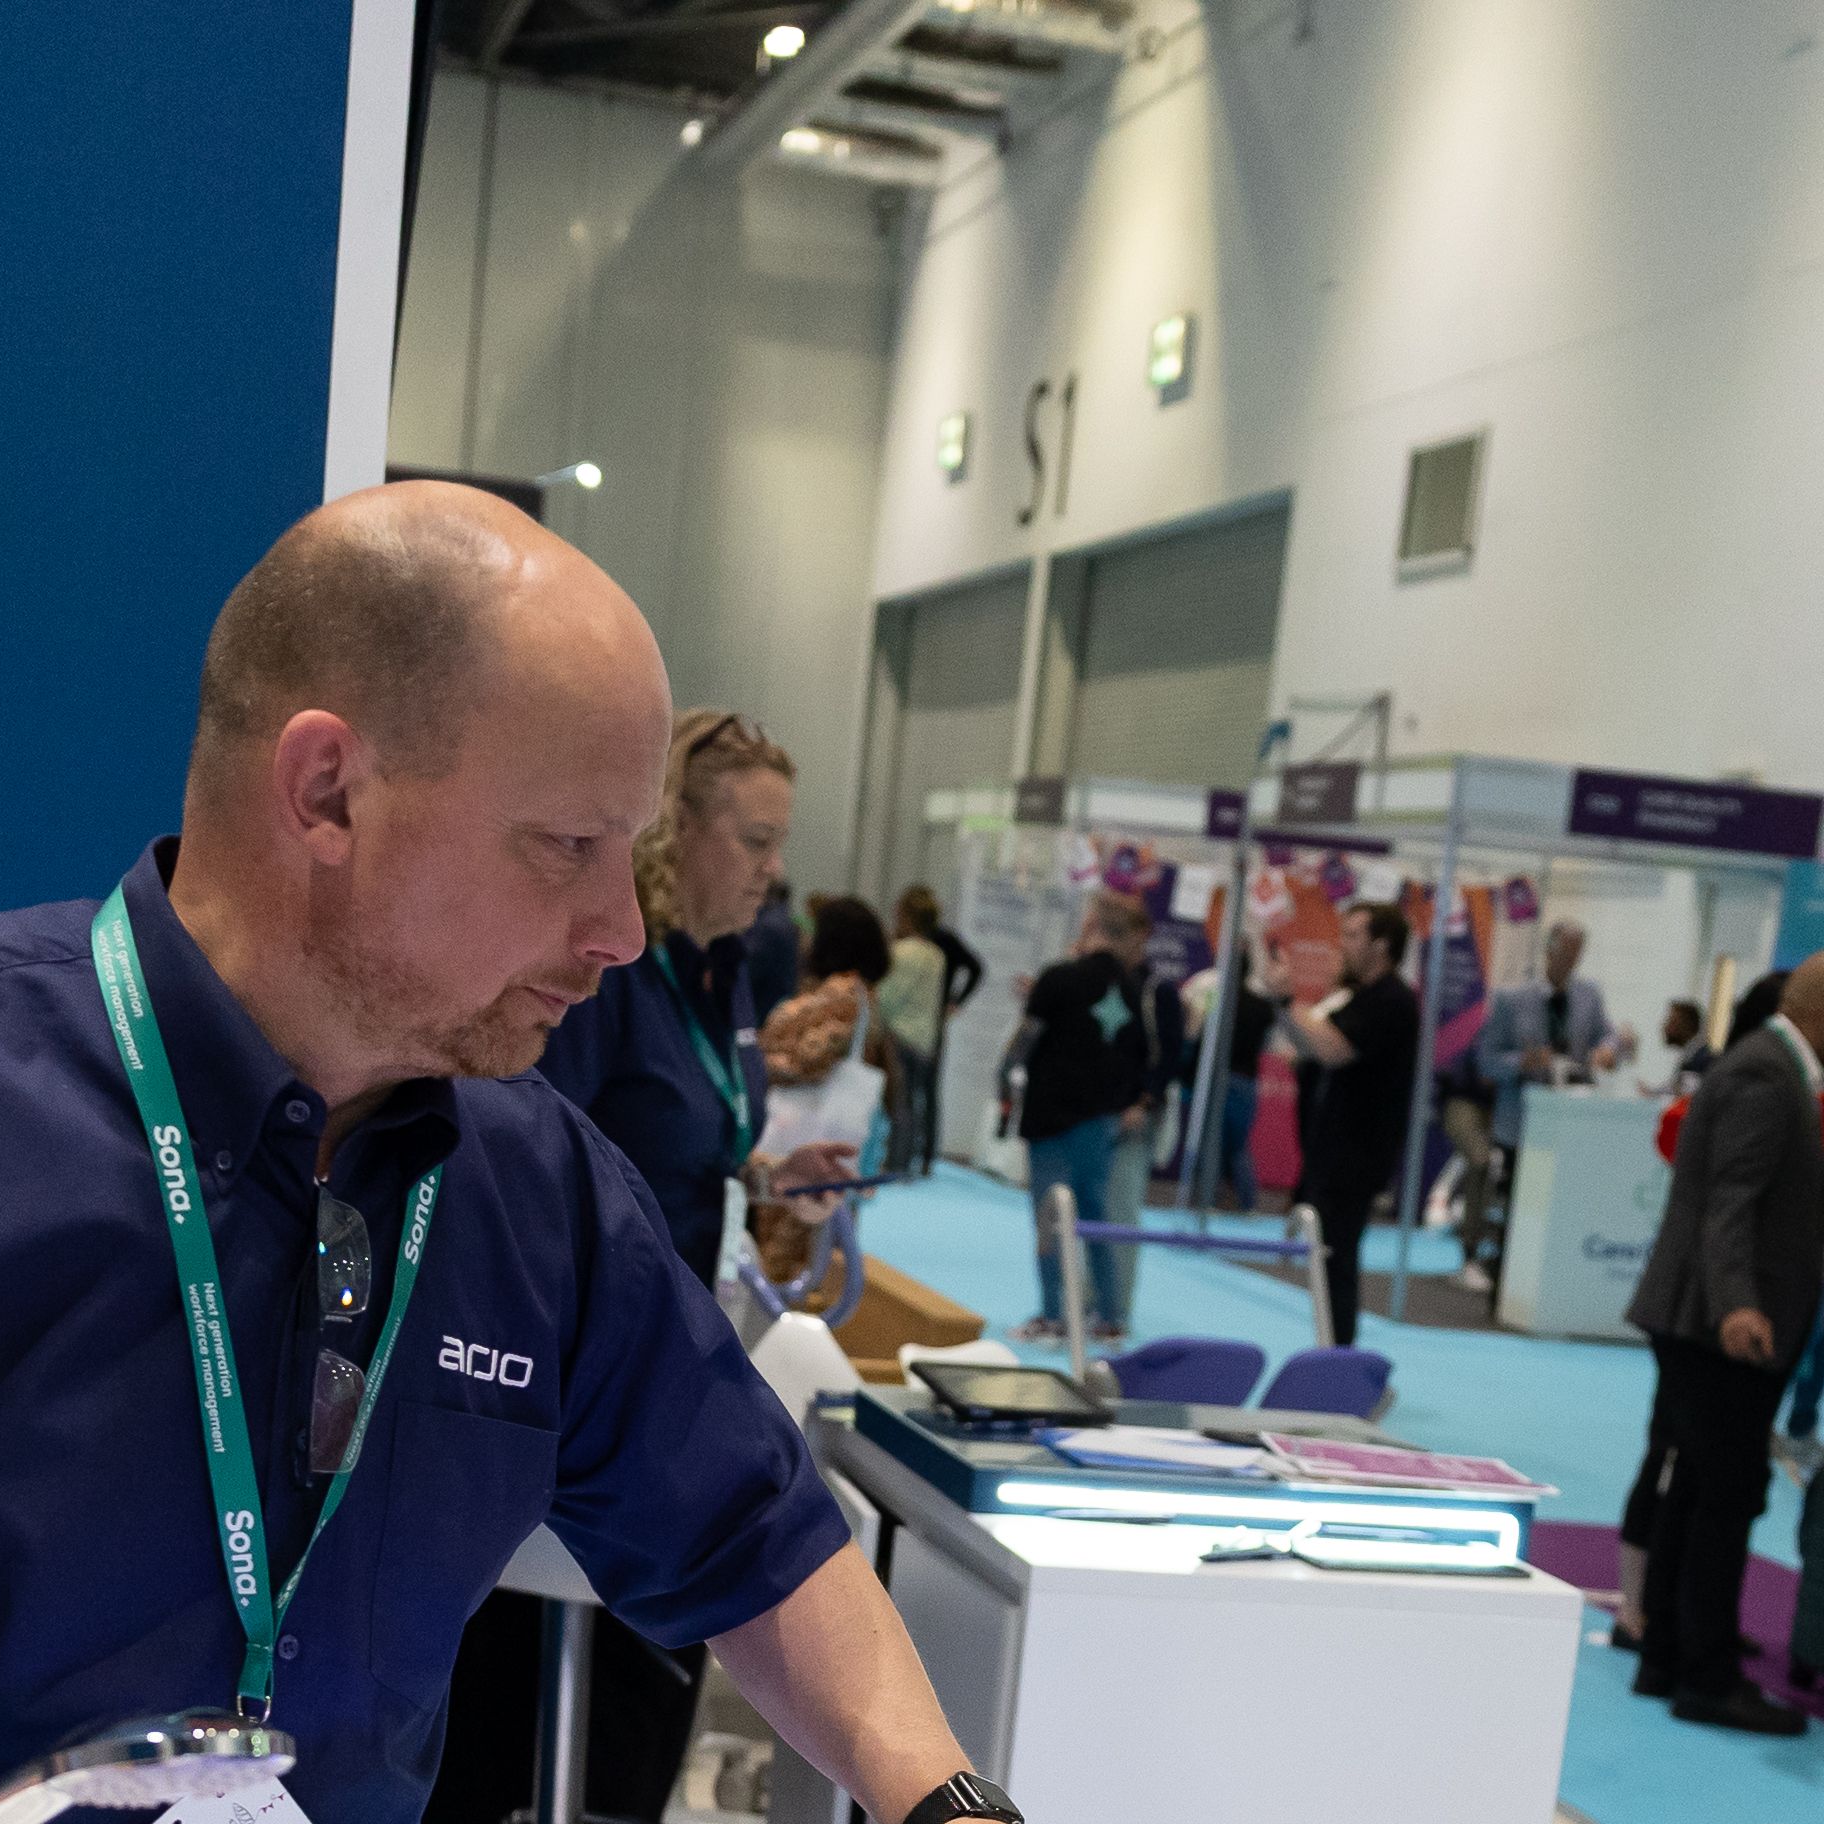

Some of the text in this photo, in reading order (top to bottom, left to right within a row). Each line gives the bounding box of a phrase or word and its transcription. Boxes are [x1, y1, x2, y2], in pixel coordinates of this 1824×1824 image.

[110, 985, 144, 1070] management
[116, 950, 144, 1018] generation
[188, 1283, 225, 1453] workforce management
[204, 1282, 232, 1397] Next generation
